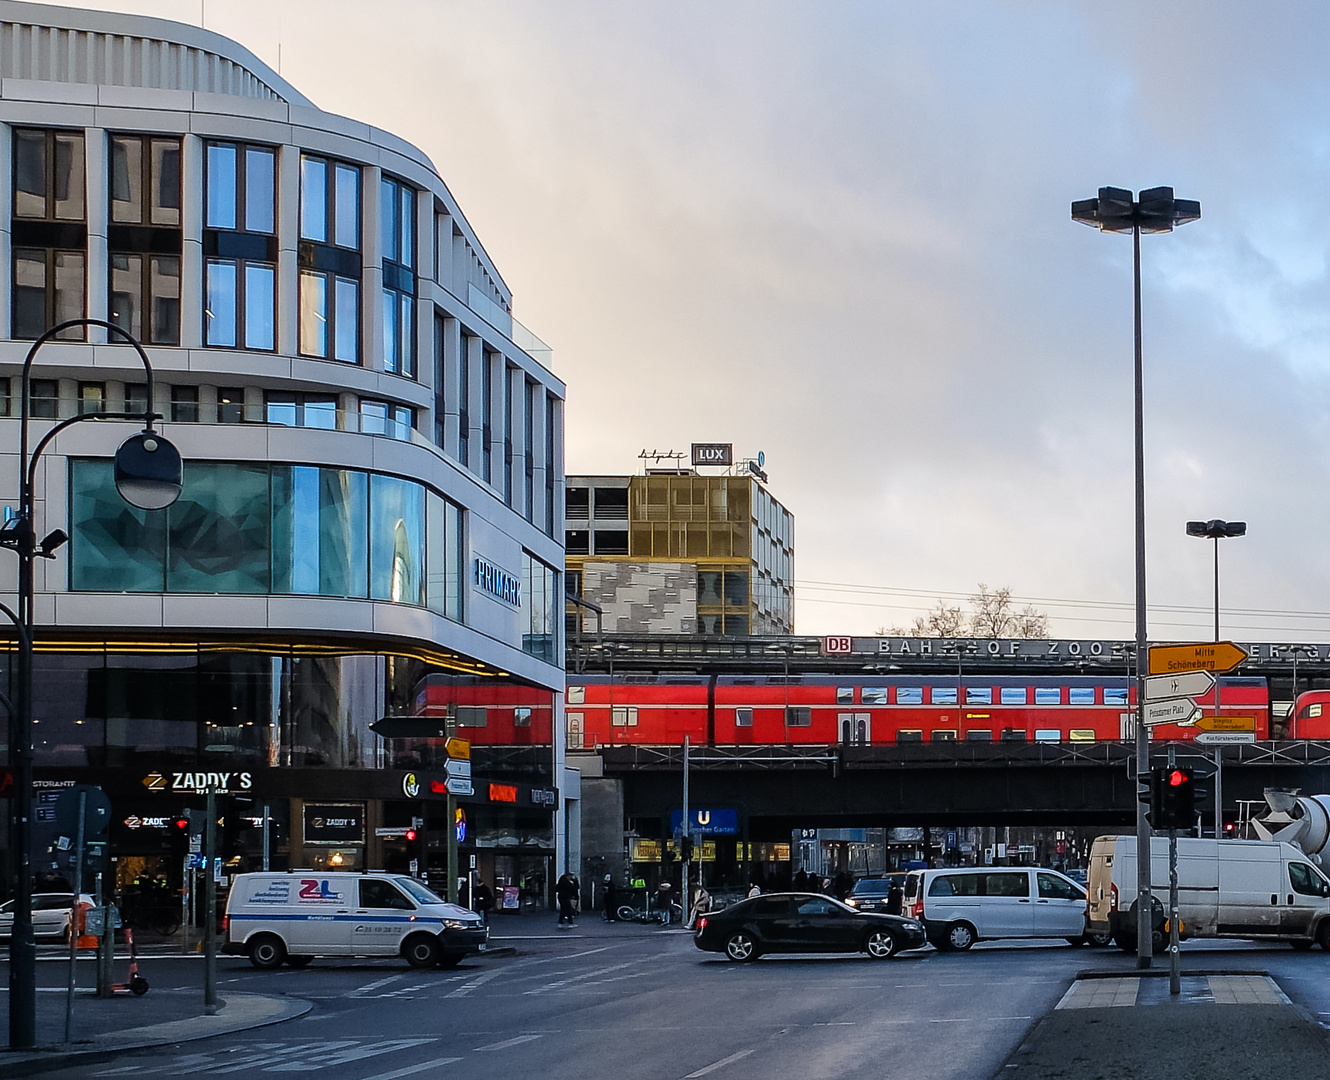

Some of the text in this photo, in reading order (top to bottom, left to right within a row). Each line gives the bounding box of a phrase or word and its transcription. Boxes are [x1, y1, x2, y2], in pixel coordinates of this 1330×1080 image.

[699, 449, 725, 460] LUX
[475, 558, 523, 608] PRIMARK
[828, 638, 850, 651] DB
[1194, 647, 1215, 657] Mitte
[1167, 660, 1216, 670] Schöneberg
[1172, 705, 1185, 715] Platz
[698, 810, 710, 825] U
